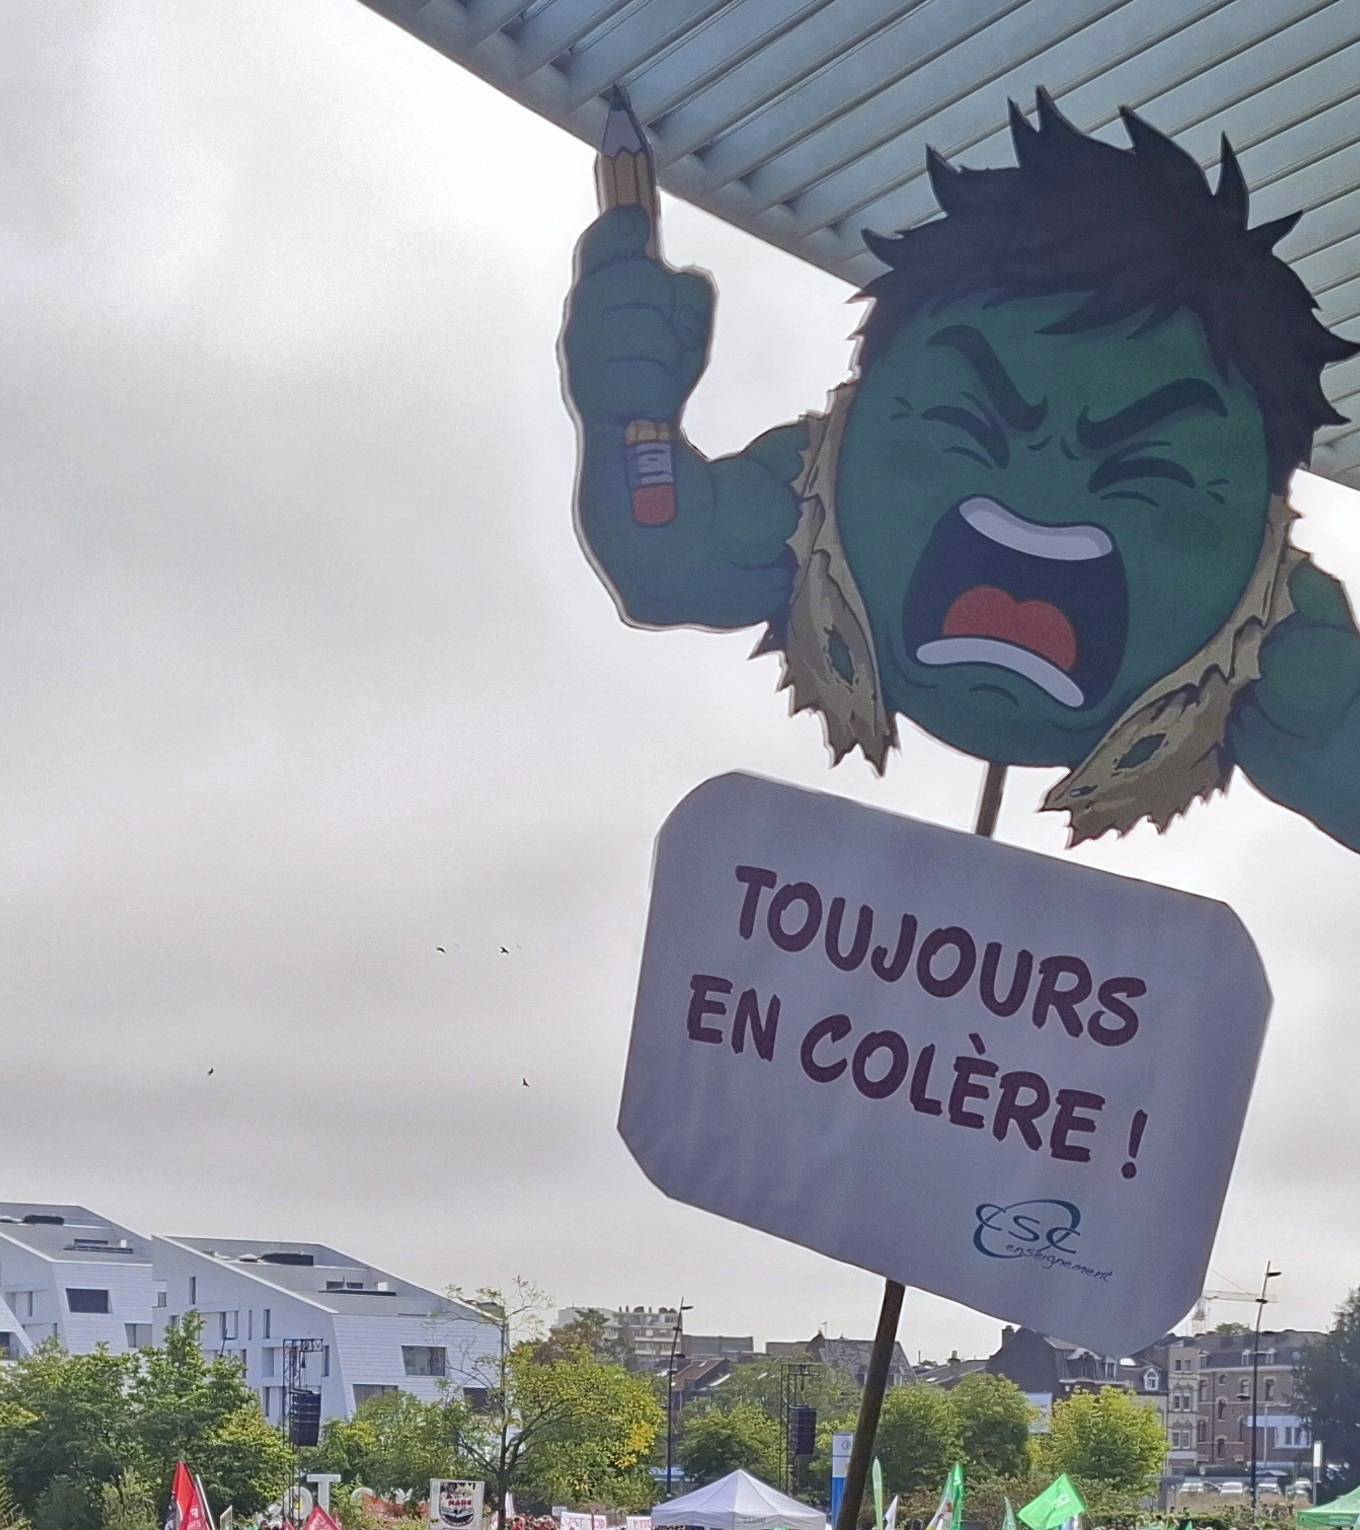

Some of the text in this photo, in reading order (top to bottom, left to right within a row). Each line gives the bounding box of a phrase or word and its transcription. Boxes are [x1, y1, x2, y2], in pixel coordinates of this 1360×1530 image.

[734, 864, 1147, 1047] TOUJOURS
[687, 973, 1150, 1180] EN COLÈRE !
[973, 1200, 1082, 1256] CSC
[1006, 1243, 1114, 1282] enseignement
